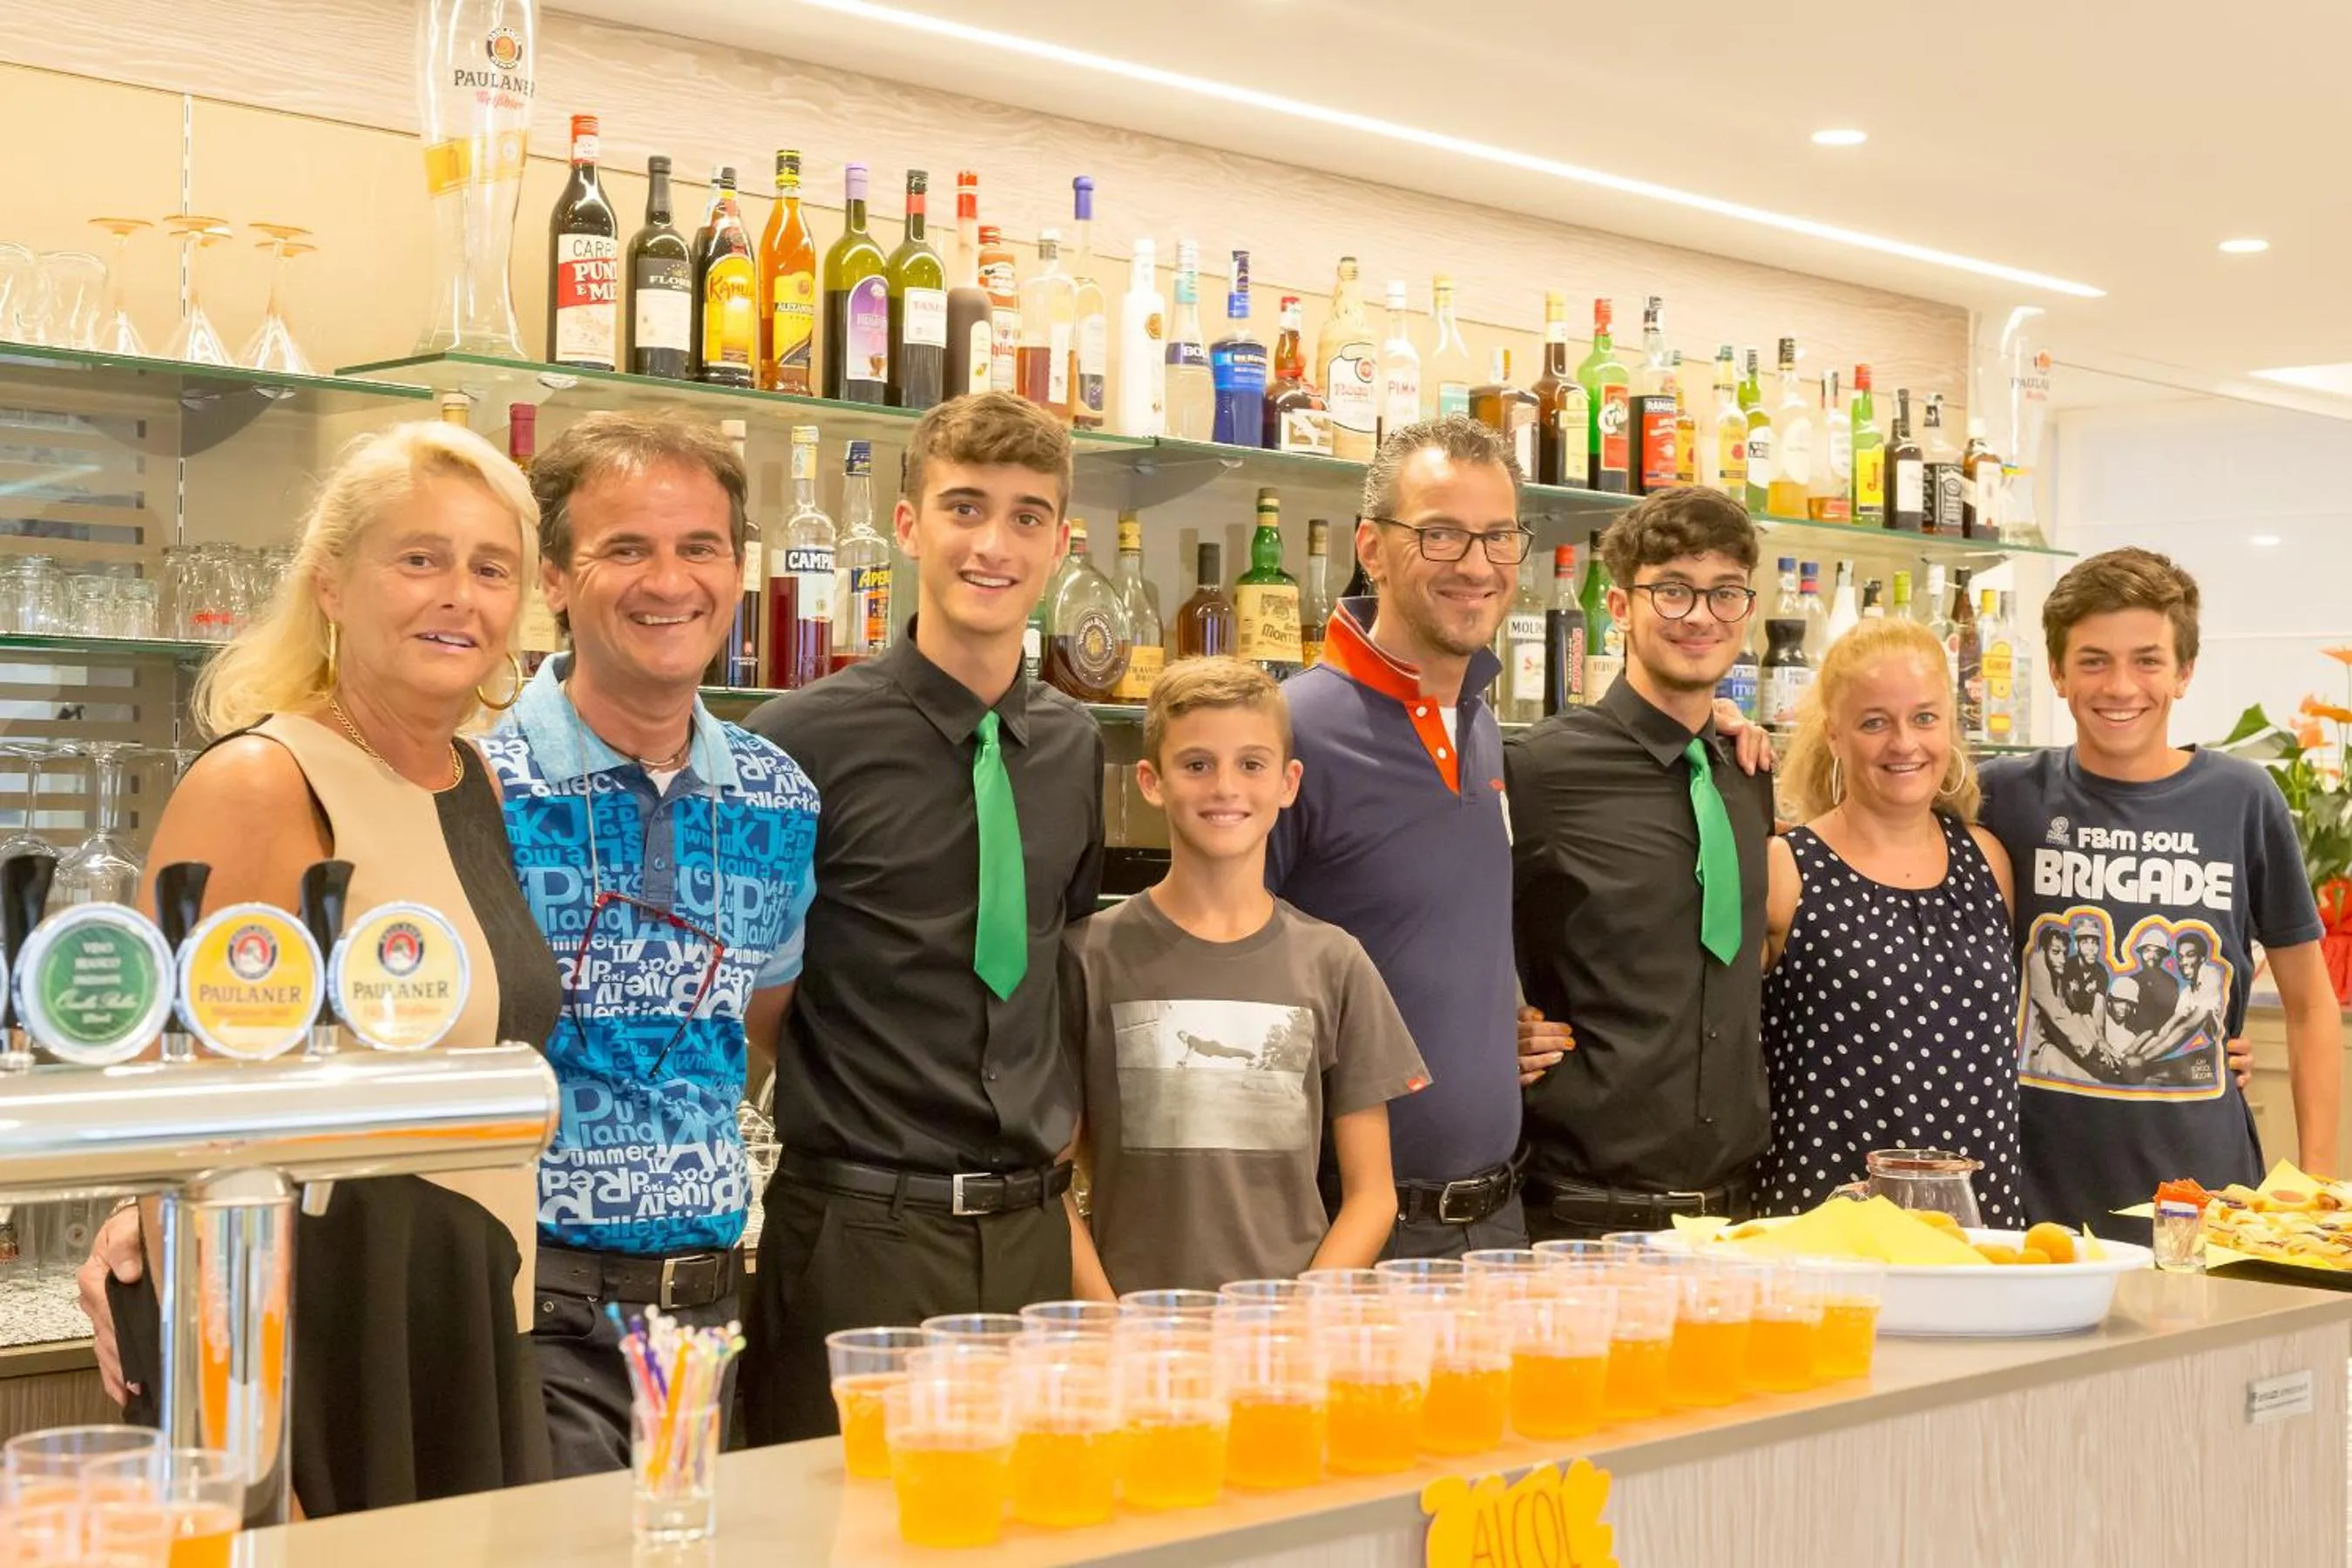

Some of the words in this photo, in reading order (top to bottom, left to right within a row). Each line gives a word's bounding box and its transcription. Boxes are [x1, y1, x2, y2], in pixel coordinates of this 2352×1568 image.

[2140, 830, 2199, 855] SOUL
[2034, 848, 2234, 911] BRIGADE
[199, 984, 301, 1004] PAULANER
[354, 981, 450, 999] PAULANER
